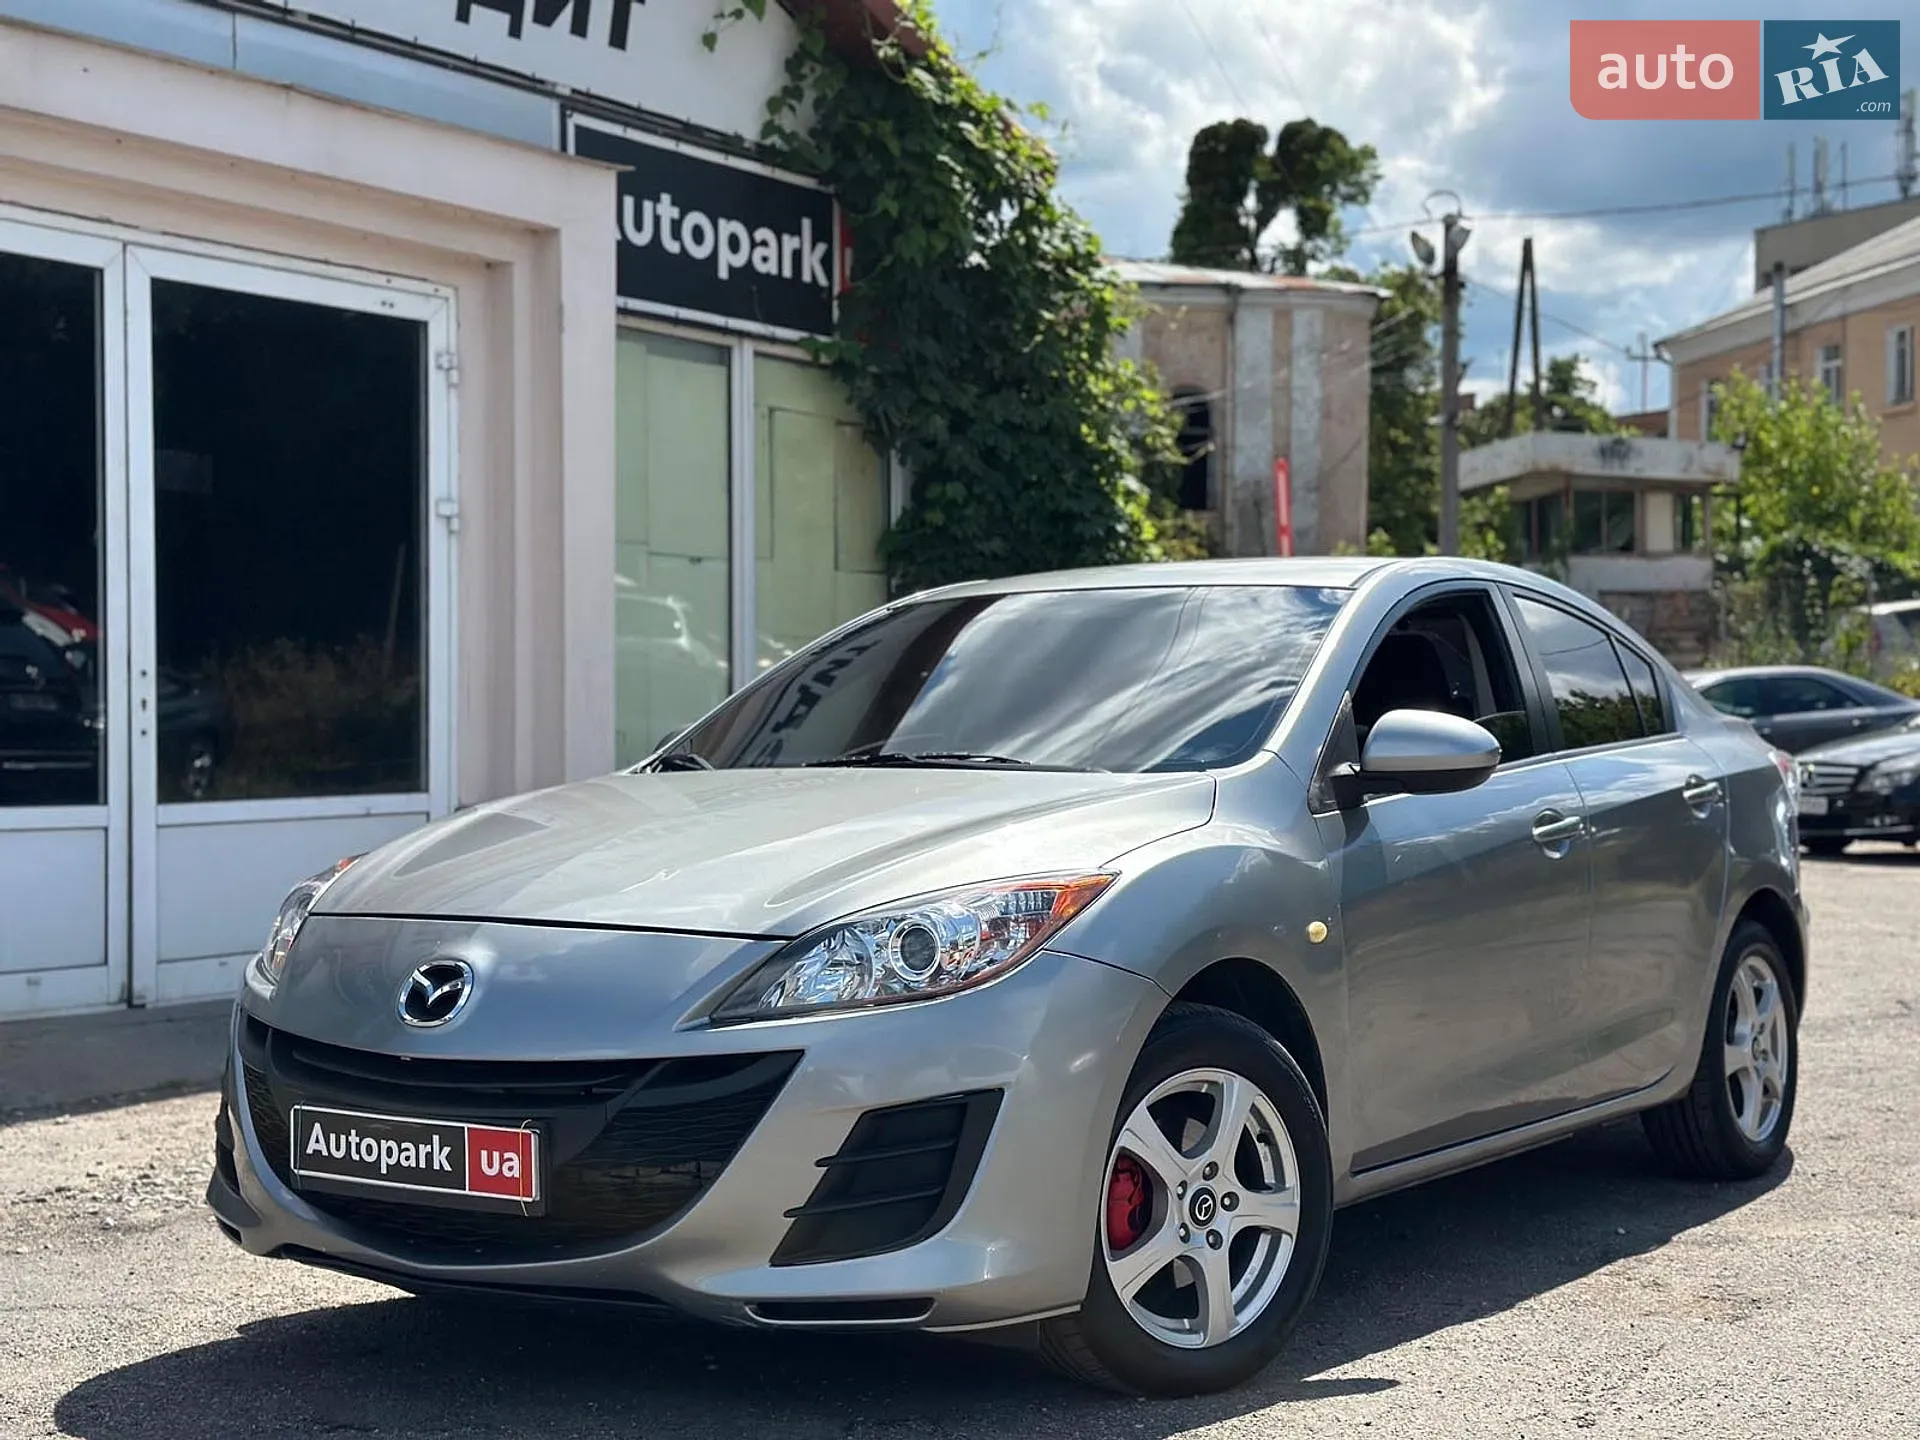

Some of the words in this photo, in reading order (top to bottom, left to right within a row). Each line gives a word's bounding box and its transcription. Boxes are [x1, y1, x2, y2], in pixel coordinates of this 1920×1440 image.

[615, 192, 829, 288] utopark
[305, 1121, 453, 1174] Autopark
[480, 1149, 521, 1178] ua
